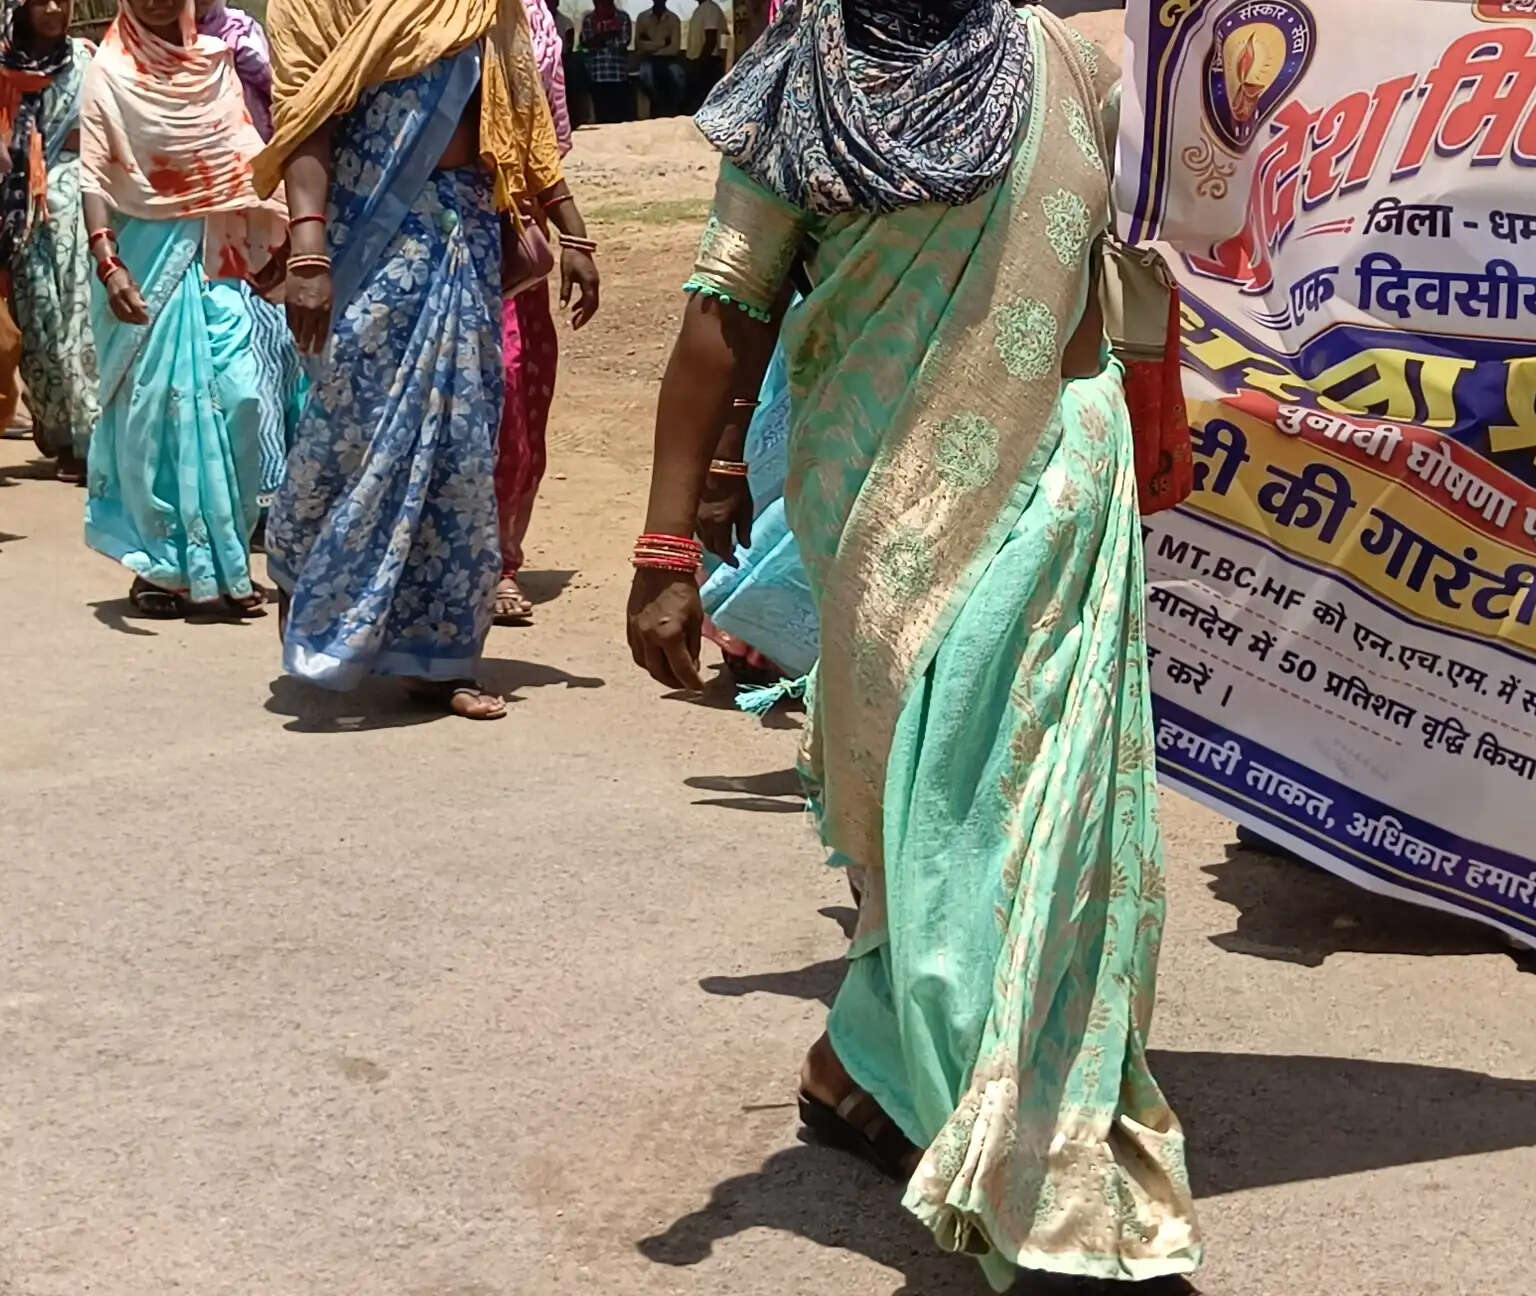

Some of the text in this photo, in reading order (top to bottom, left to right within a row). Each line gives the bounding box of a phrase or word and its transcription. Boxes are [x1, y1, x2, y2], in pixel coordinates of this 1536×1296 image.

[1237, 1, 1288, 21] संस्कार
[1291, 24, 1309, 54] सेवा
[1362, 196, 1454, 238] जिला
[1288, 266, 1339, 328] एक
[1275, 403, 1404, 464] चुनावी
[1405, 441, 1518, 529] घोषणा
[1257, 462, 1358, 545] की
[1147, 585, 1244, 647] मानदेय
[1247, 630, 1278, 662] में
[1277, 650, 1318, 683] 50
[1323, 670, 1417, 730] प्रतिशत
[1421, 714, 1472, 755] वृद्धि
[1165, 655, 1214, 695] करें
[1312, 599, 1348, 634] को
[1351, 622, 1489, 696] एन.एच.एम.
[1495, 675, 1522, 705] में
[1155, 717, 1242, 777] हमारी
[1245, 758, 1336, 830] ताकत,
[1345, 812, 1463, 877] अधिकार
